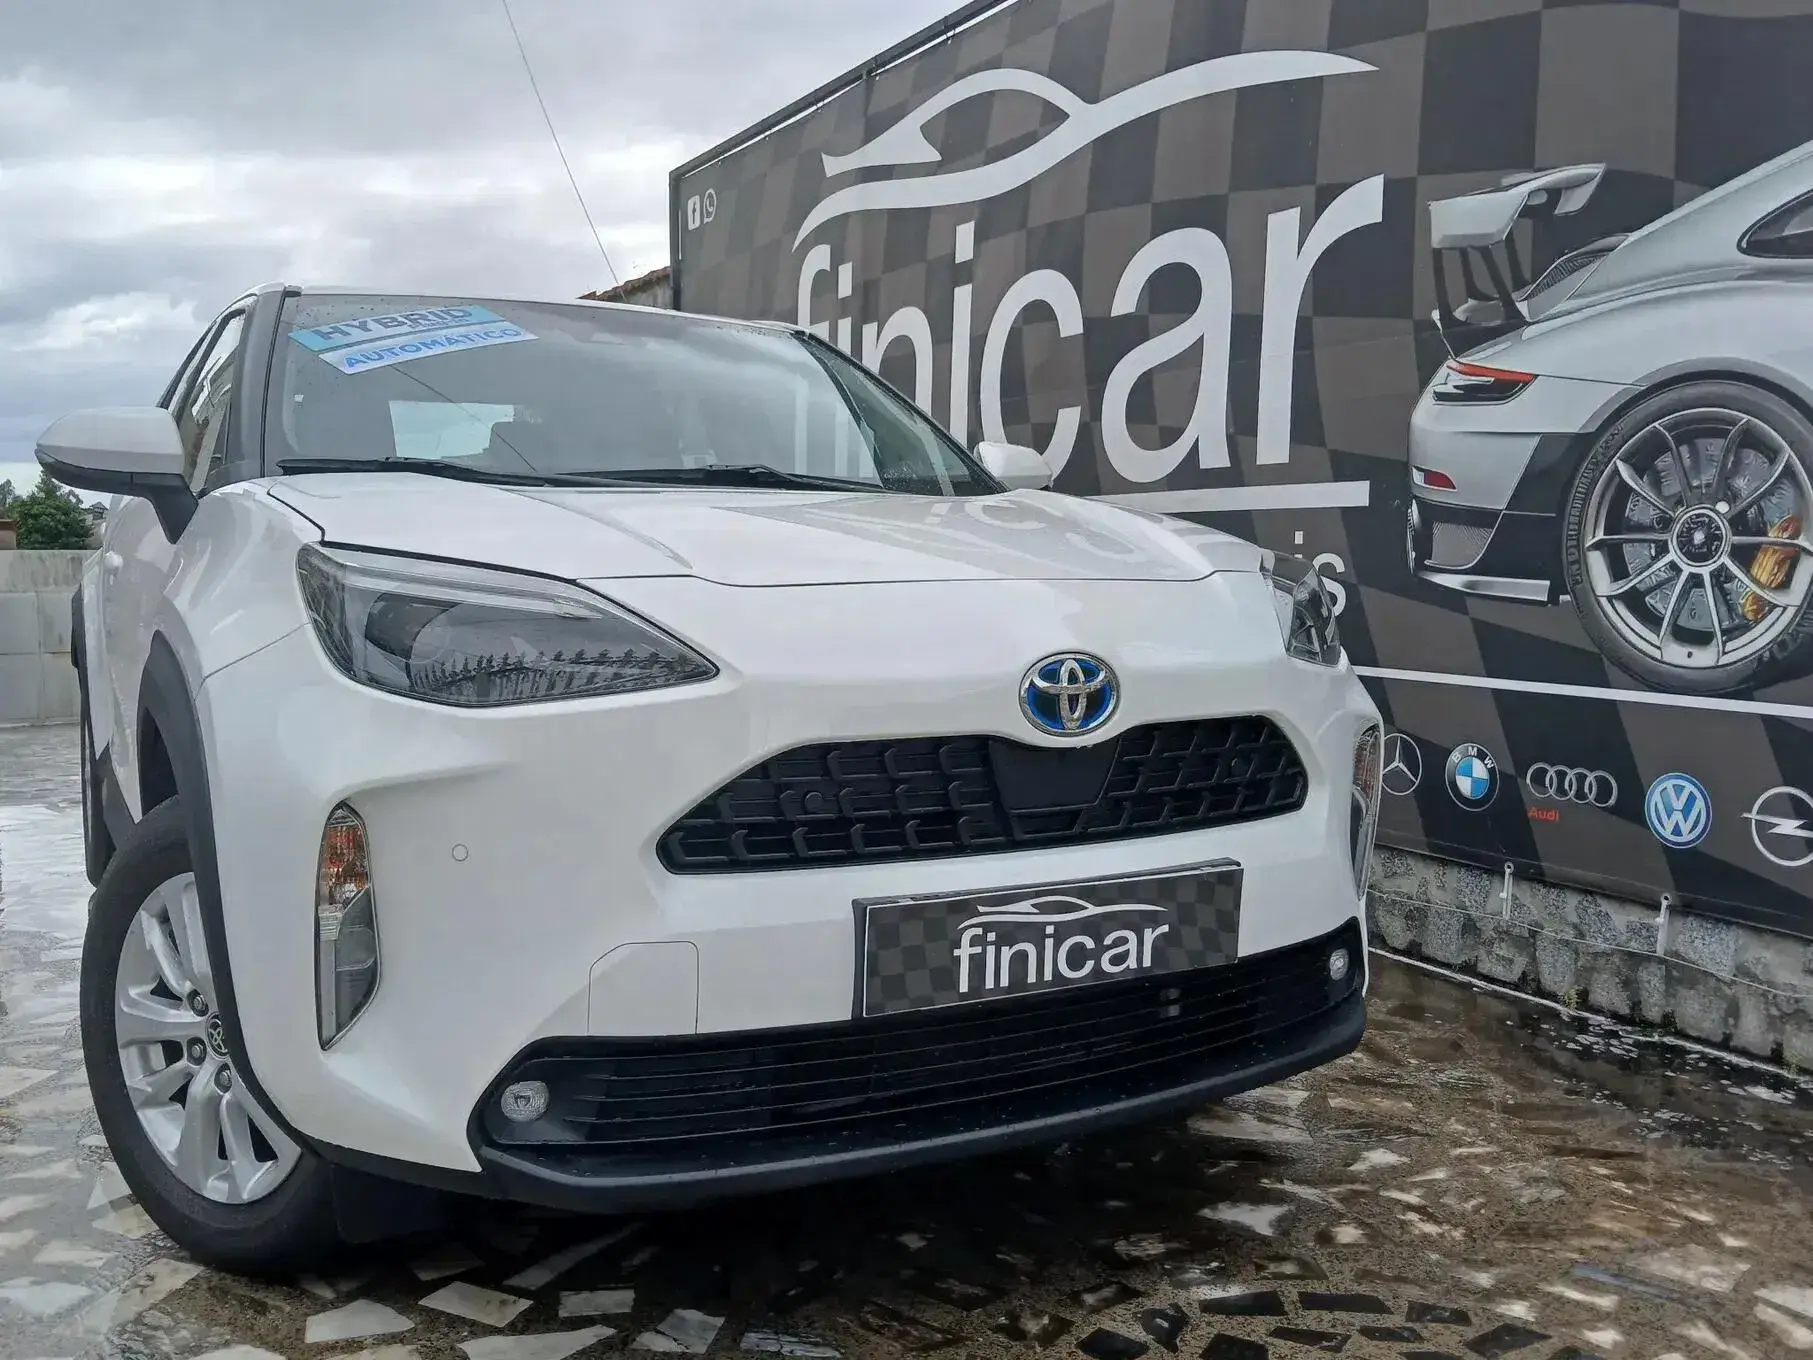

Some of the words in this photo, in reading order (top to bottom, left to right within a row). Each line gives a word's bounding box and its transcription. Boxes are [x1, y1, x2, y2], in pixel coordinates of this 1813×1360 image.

[311, 306, 473, 341] HYBRID
[345, 328, 522, 368] AUTOMÁTICO
[1451, 746, 1495, 769] BMW
[1527, 806, 1560, 822] Audi
[953, 924, 1169, 993] finicar
